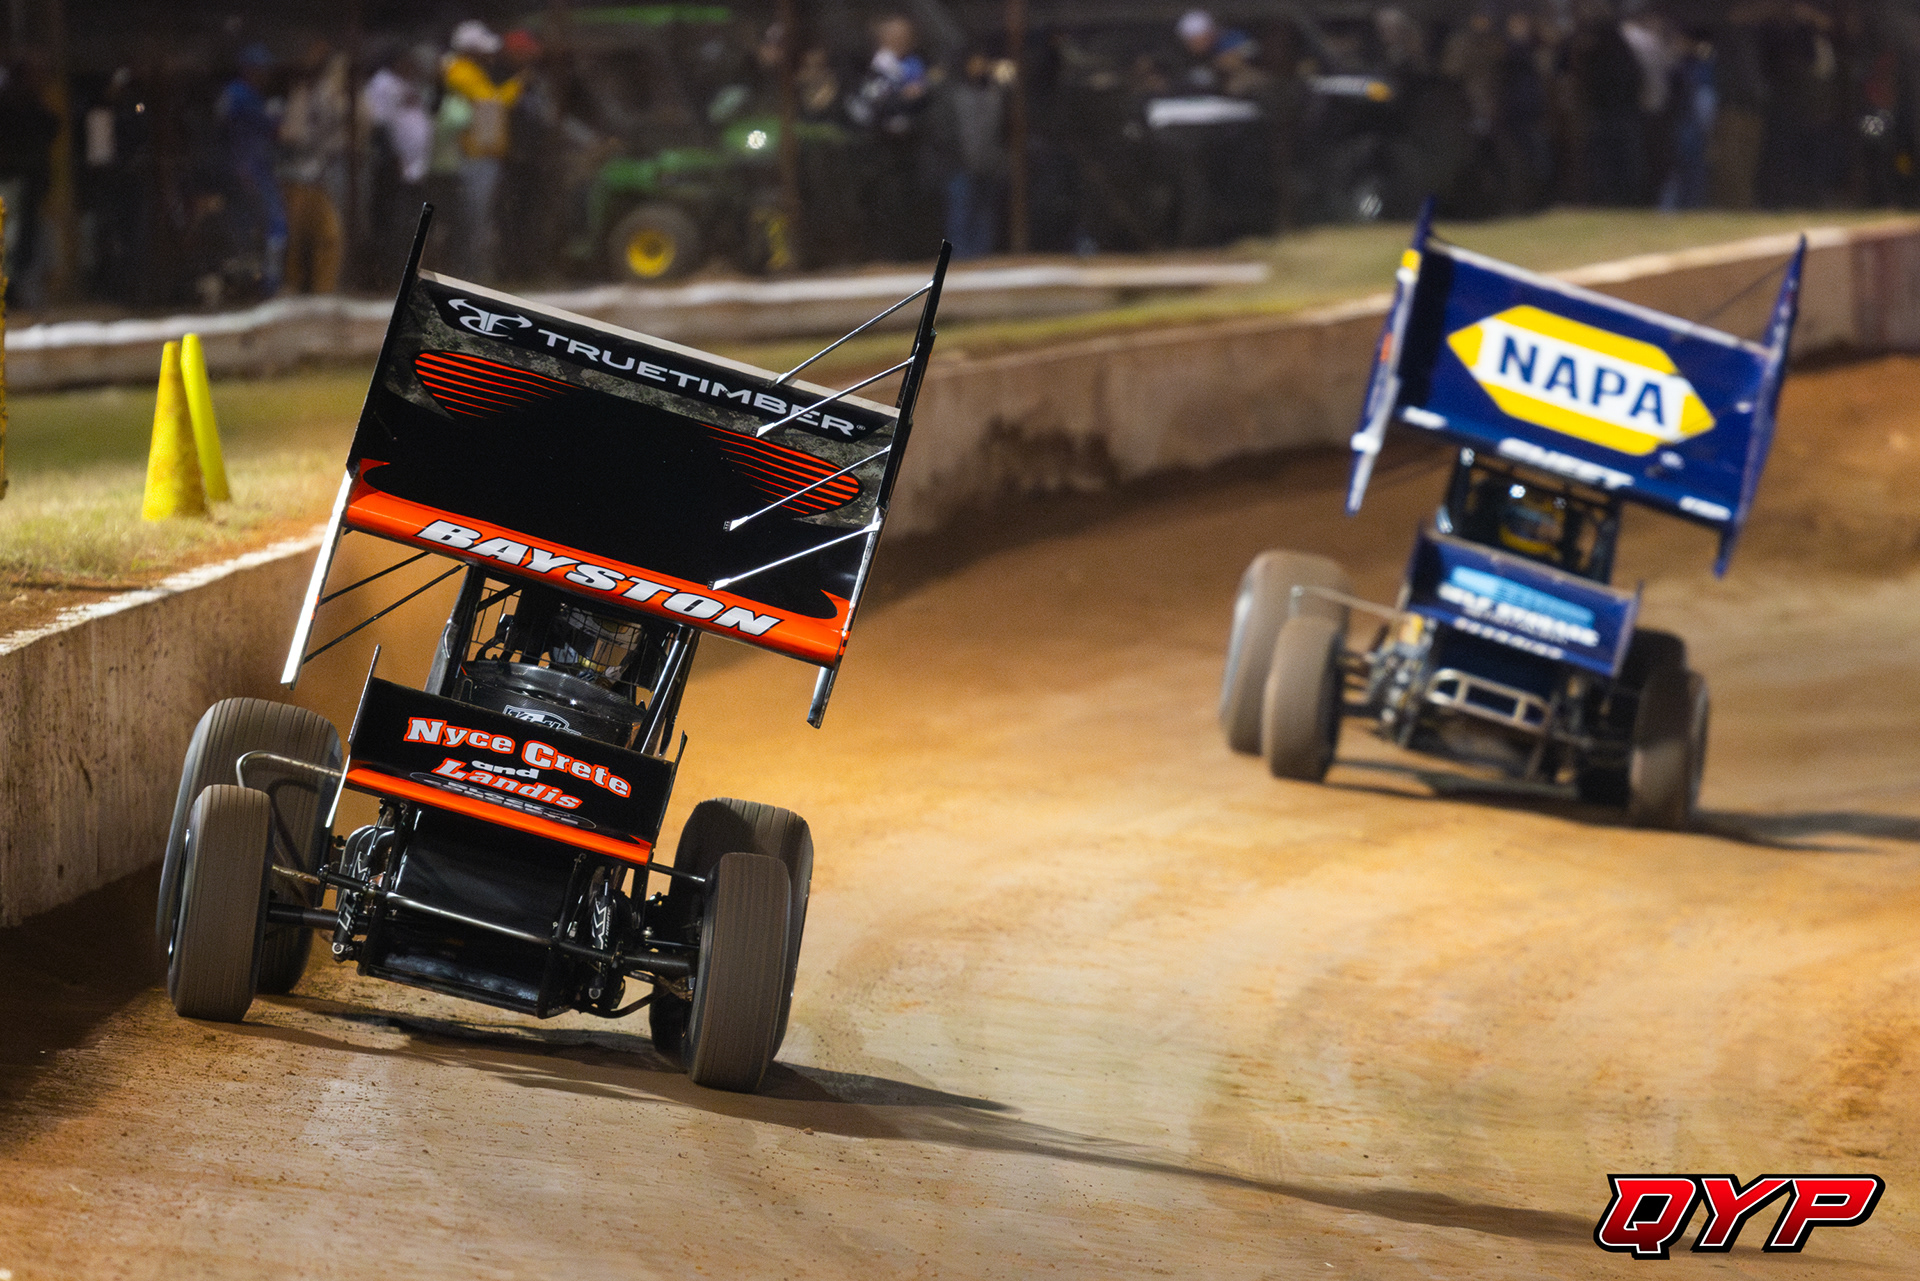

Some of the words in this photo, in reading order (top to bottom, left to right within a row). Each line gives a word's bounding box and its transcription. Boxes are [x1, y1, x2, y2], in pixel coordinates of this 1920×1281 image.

[538, 328, 855, 437] TRUETIMBER
[1497, 335, 1666, 428] NAPA
[416, 520, 783, 637] BAYSTON
[404, 717, 515, 755] Nyce
[522, 739, 632, 798] Crete
[432, 758, 582, 809] Landis
[471, 759, 539, 780] and
